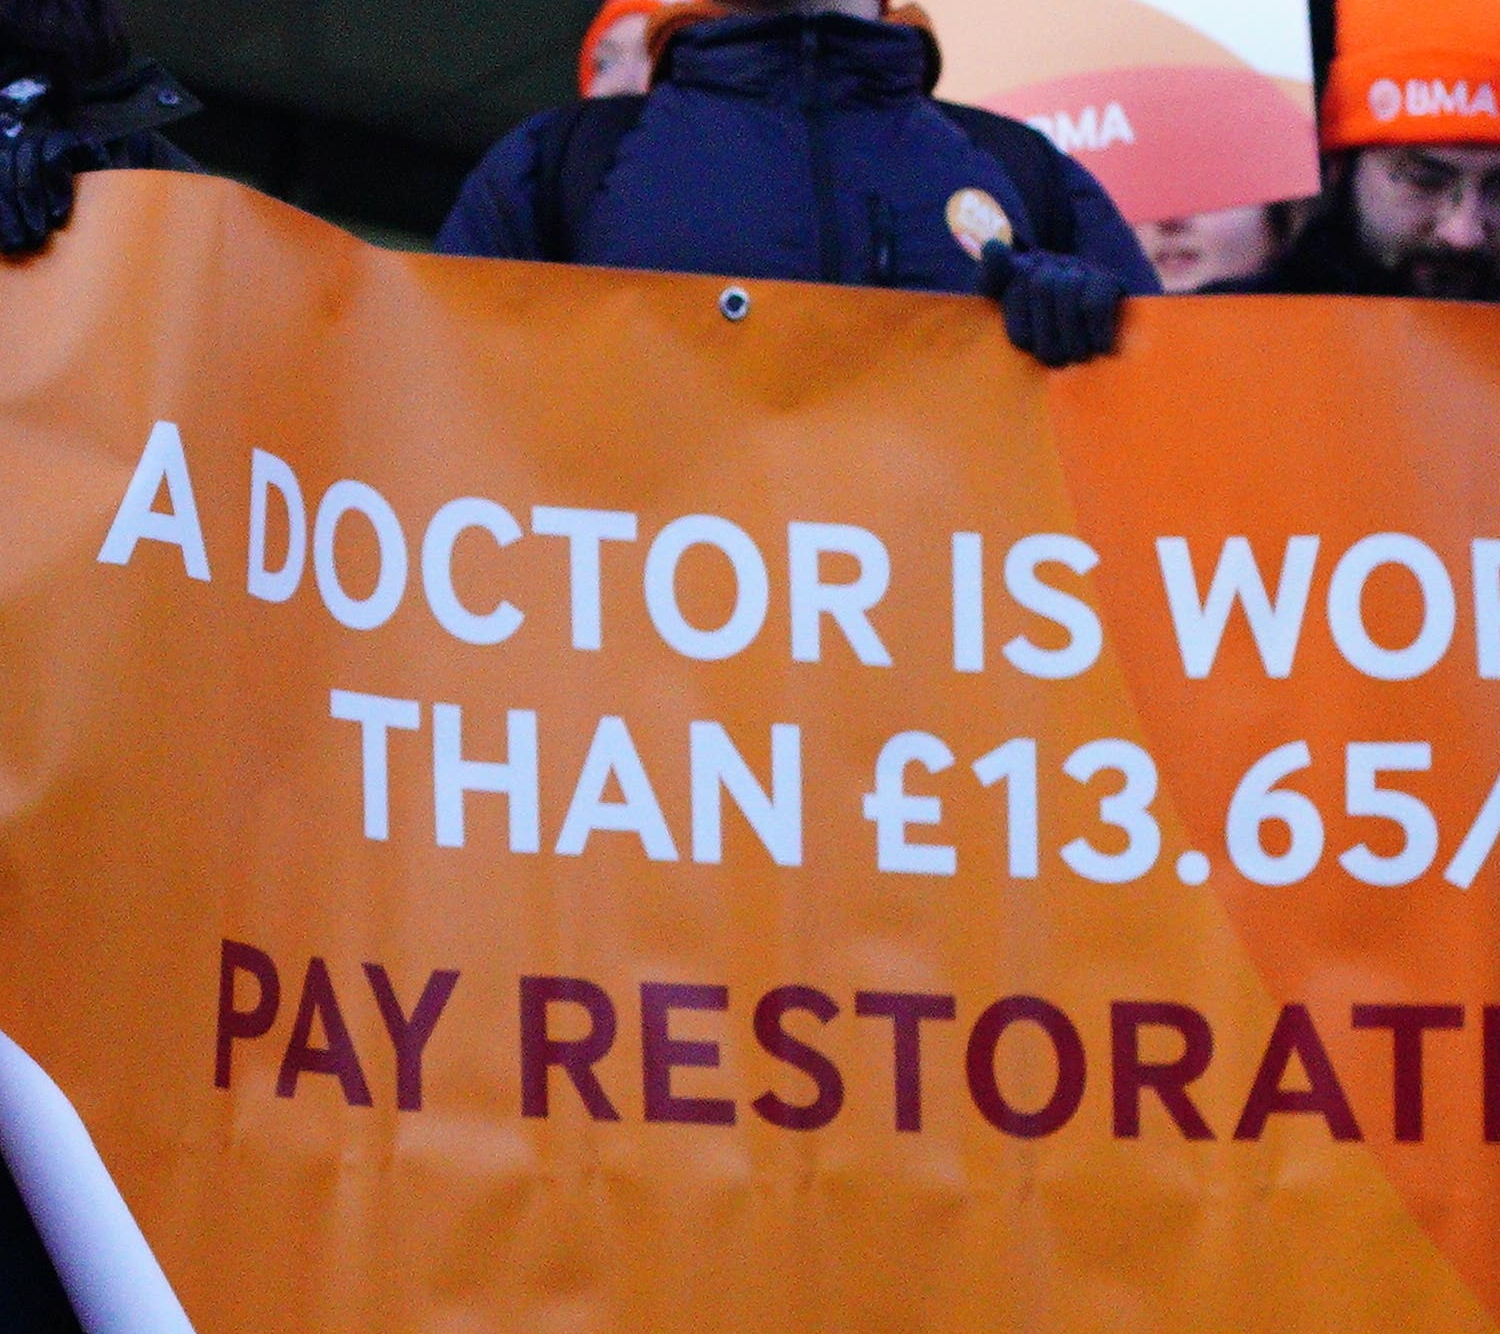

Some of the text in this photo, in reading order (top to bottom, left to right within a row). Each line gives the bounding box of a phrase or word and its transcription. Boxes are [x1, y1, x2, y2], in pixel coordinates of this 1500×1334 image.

[1405, 77, 1500, 120] BMA
[95, 419, 213, 585] A
[244, 445, 893, 671] DOCTOR
[952, 530, 1107, 681] IS
[329, 688, 804, 869] THAN
[212, 937, 462, 1114] PAY
